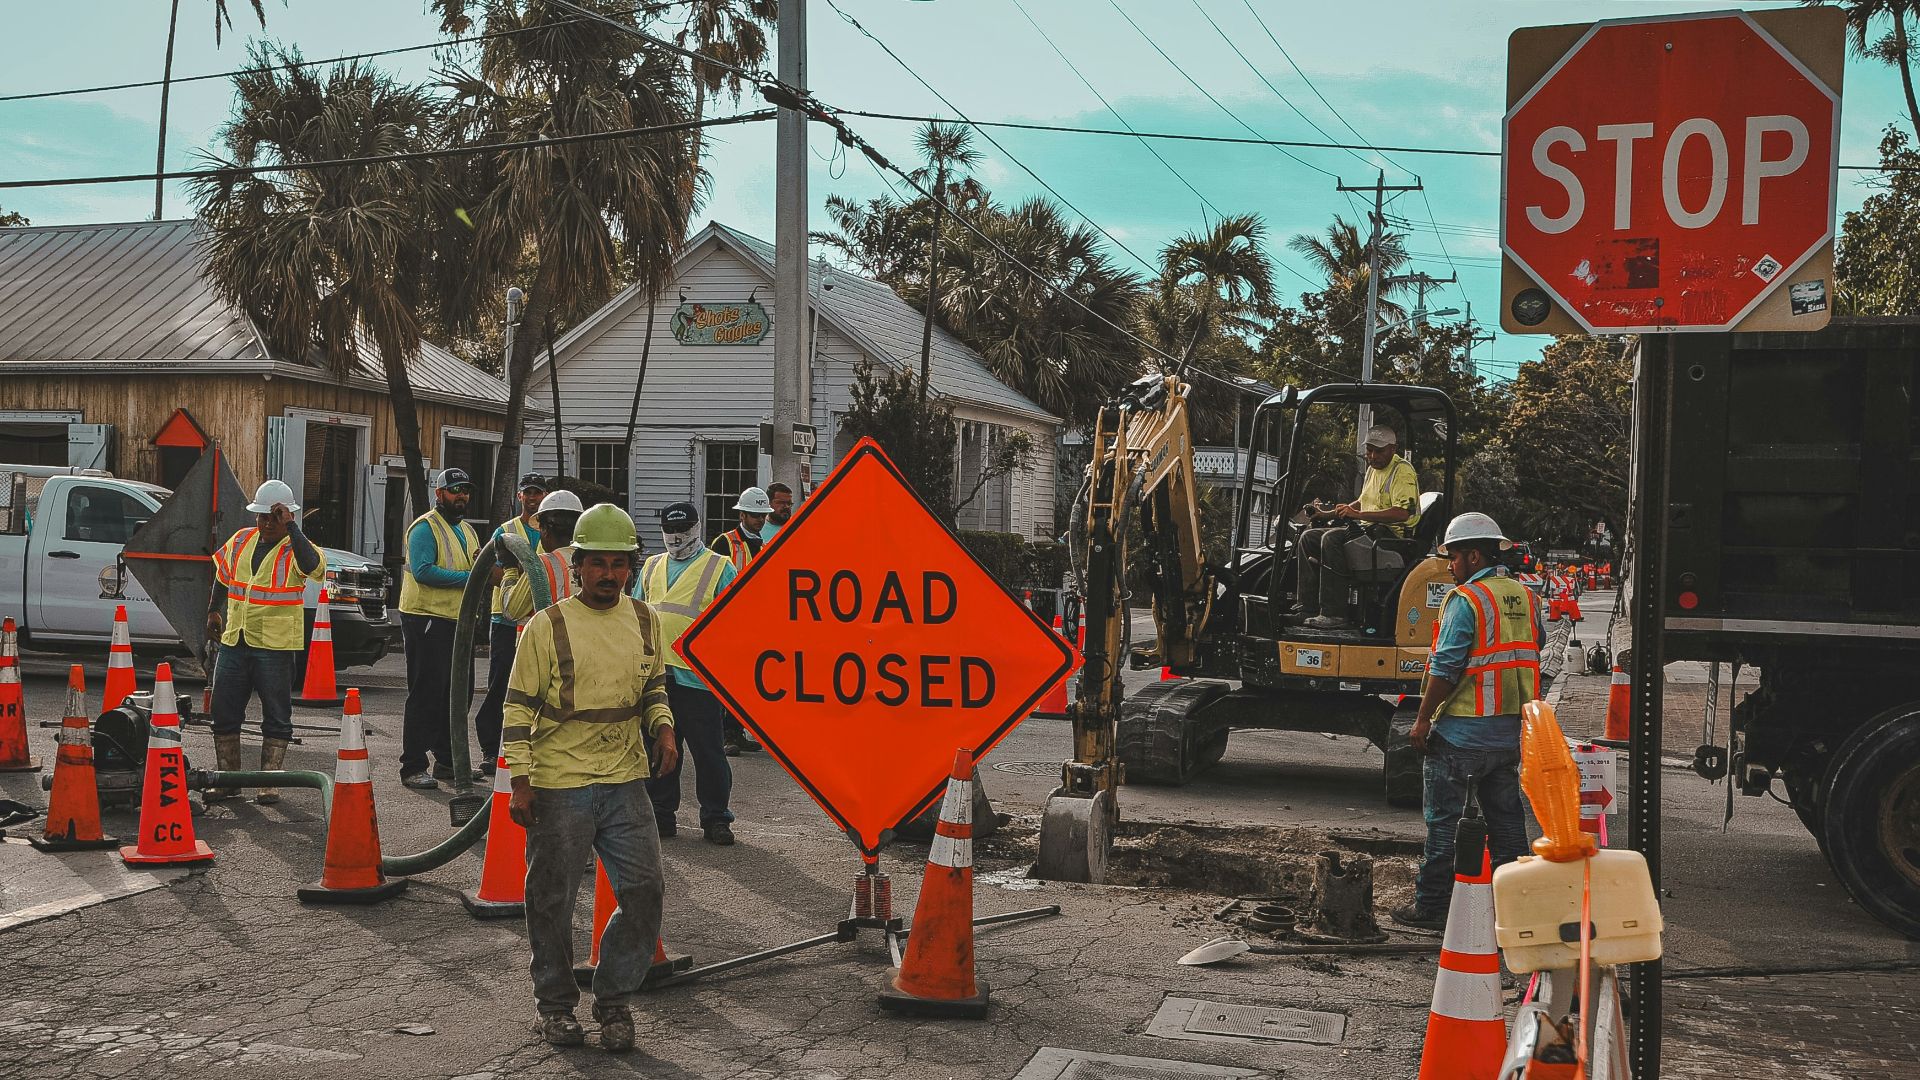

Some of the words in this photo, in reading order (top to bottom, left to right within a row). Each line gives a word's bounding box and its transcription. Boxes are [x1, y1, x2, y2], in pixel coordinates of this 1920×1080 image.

[1526, 115, 1810, 234] STOP
[696, 307, 739, 329] Shots
[714, 321, 762, 343] Giggles
[788, 569, 957, 625] ROAD
[1306, 655, 1320, 665] 36
[754, 650, 996, 709] CLOSED
[160, 753, 179, 807] FKAA
[154, 822, 182, 842] CC
